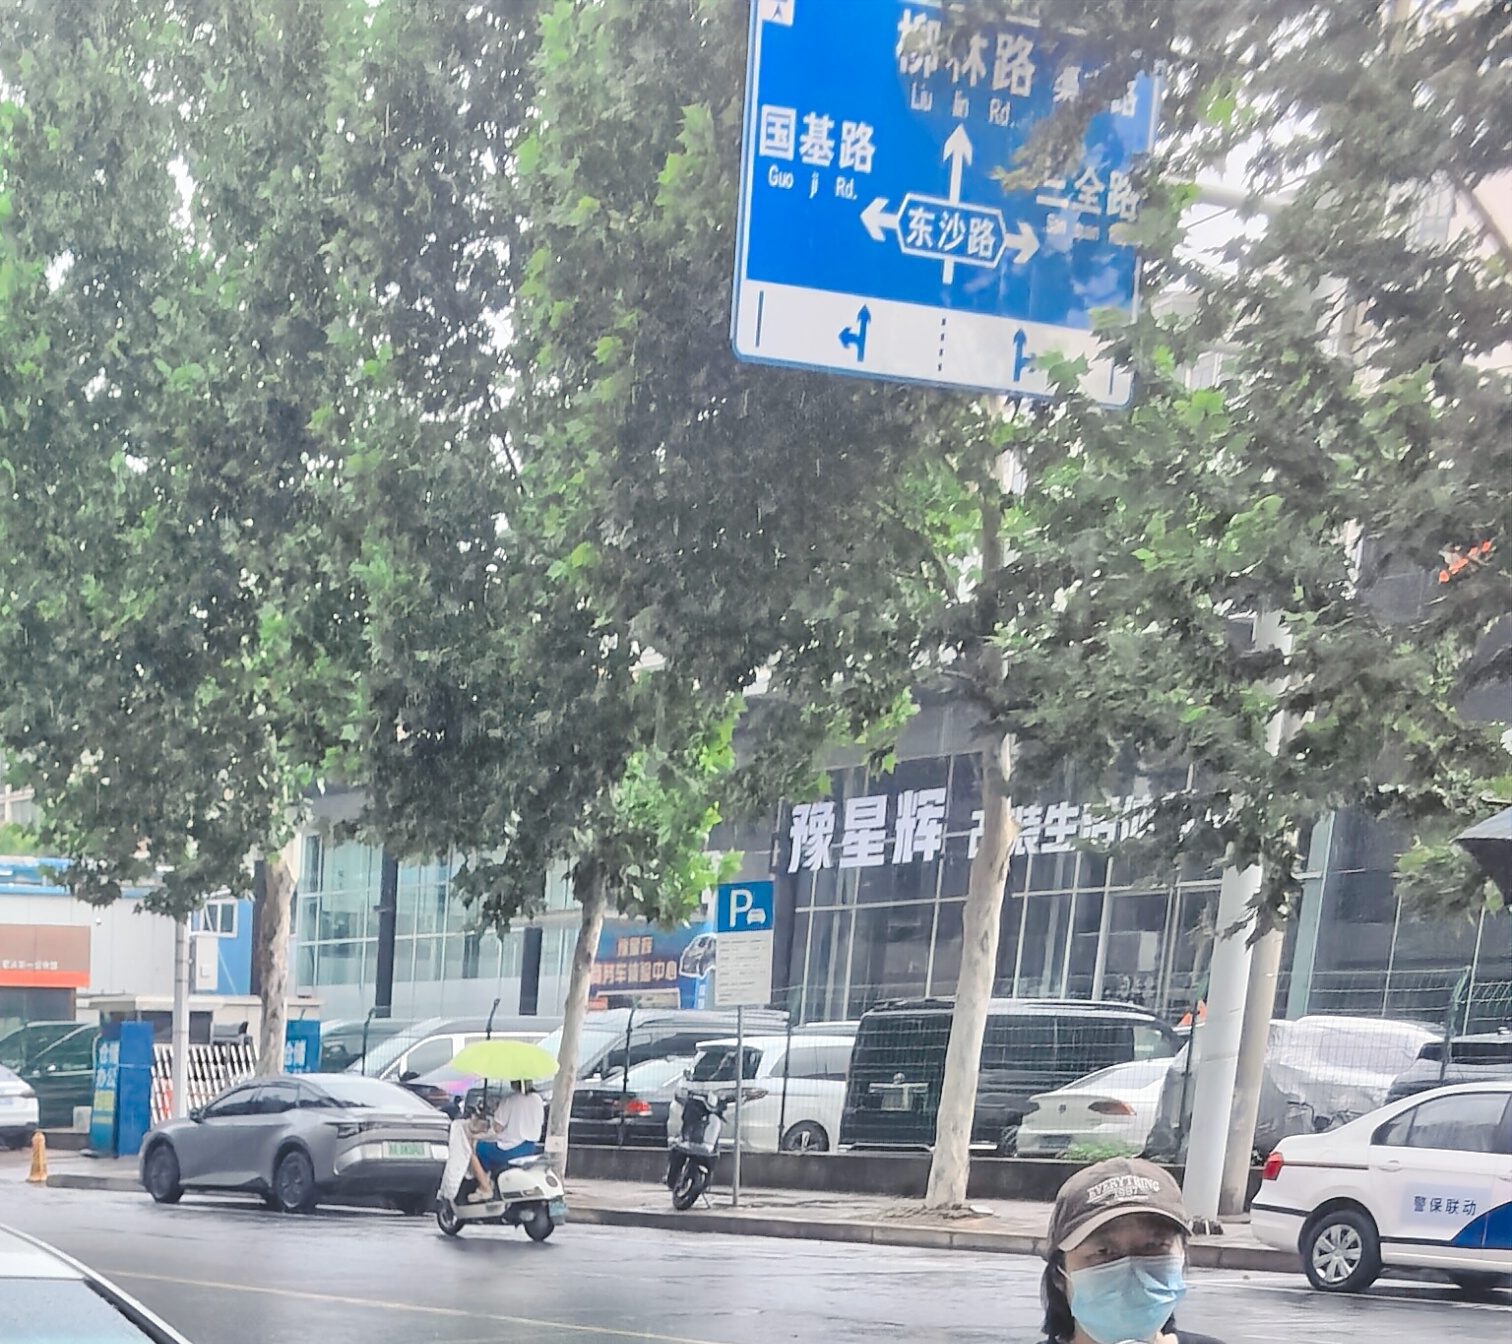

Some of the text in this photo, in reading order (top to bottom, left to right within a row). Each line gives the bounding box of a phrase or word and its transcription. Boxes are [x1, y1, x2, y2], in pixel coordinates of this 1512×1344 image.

[911, 82, 933, 112] Liu
[759, 104, 876, 174] 国基路
[768, 168, 858, 201] Guo ji Rd.
[906, 206, 996, 259] 东沙路
[789, 787, 947, 873] 豫星辉
[1414, 1196, 1477, 1216] 警保联动
